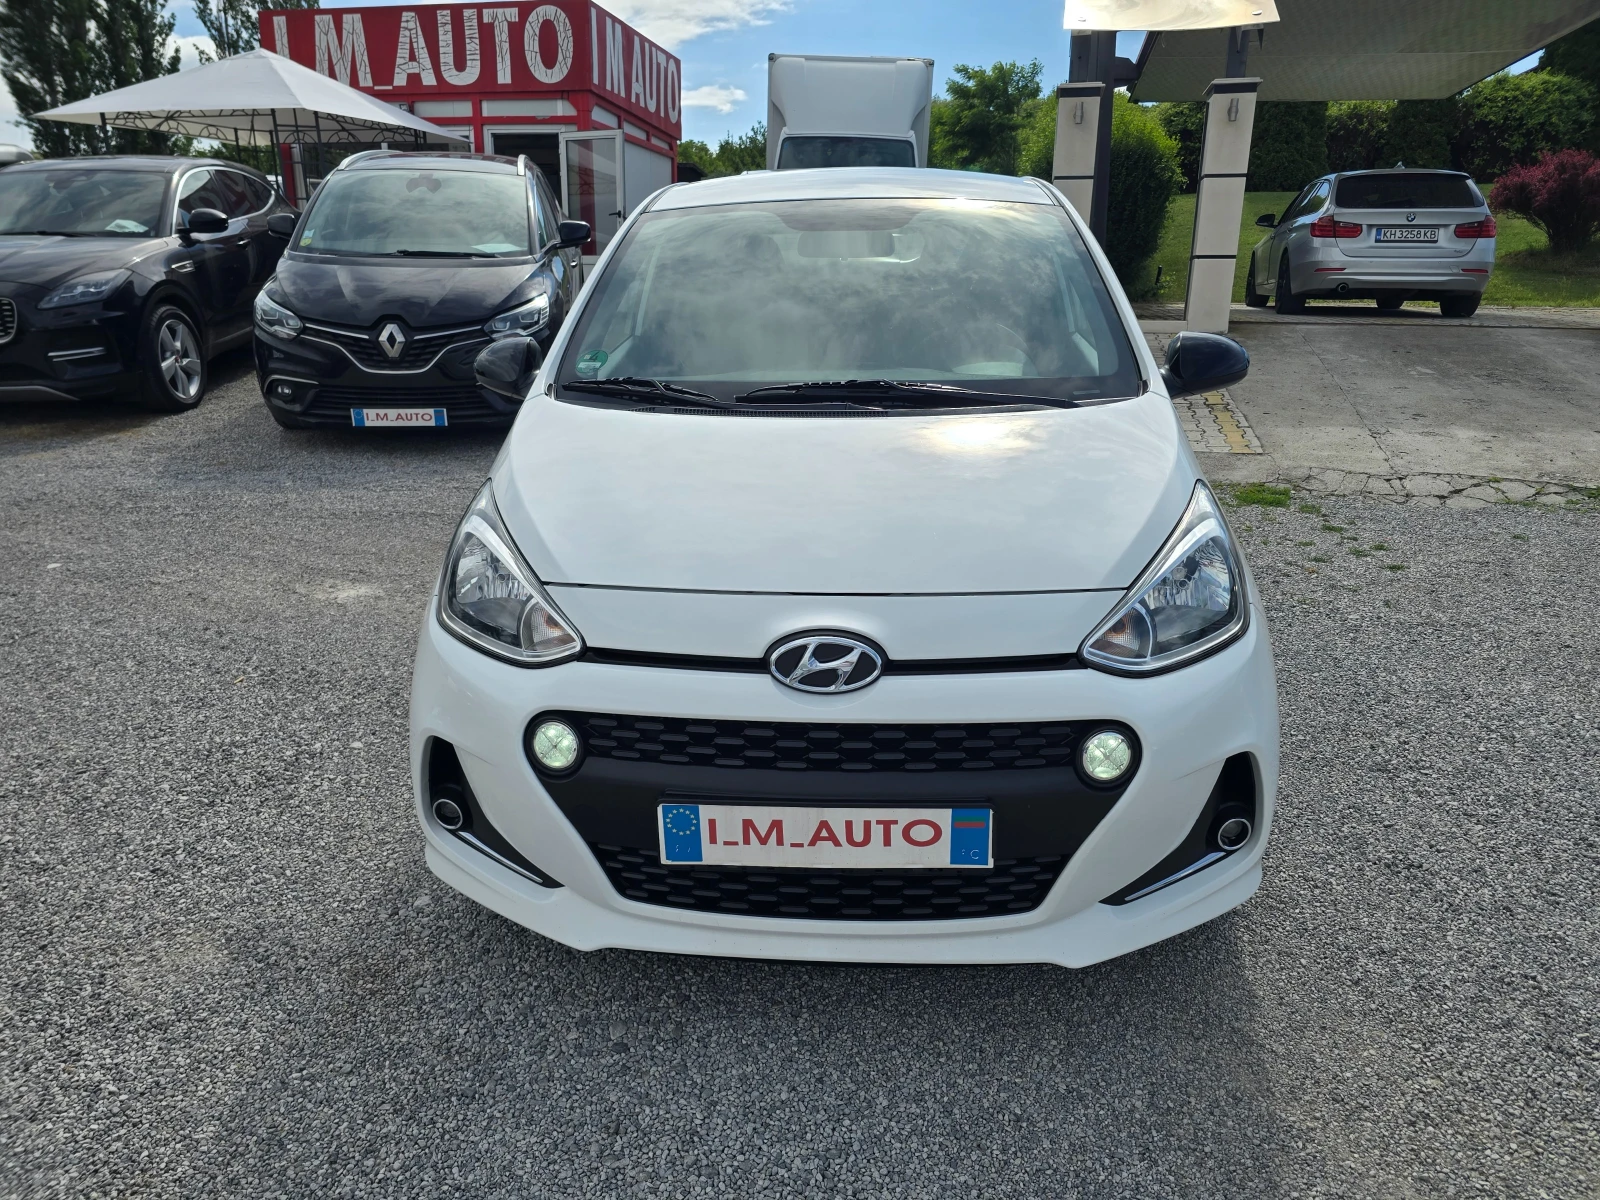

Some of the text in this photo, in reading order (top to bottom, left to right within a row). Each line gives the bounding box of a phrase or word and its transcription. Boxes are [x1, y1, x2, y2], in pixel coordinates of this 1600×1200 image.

[631, 35, 680, 124] AUTO
[1383, 230, 1396, 239] KH
[1398, 230, 1421, 239] 3258
[1424, 230, 1436, 239] KB
[708, 819, 943, 848] I_M_AUTO
